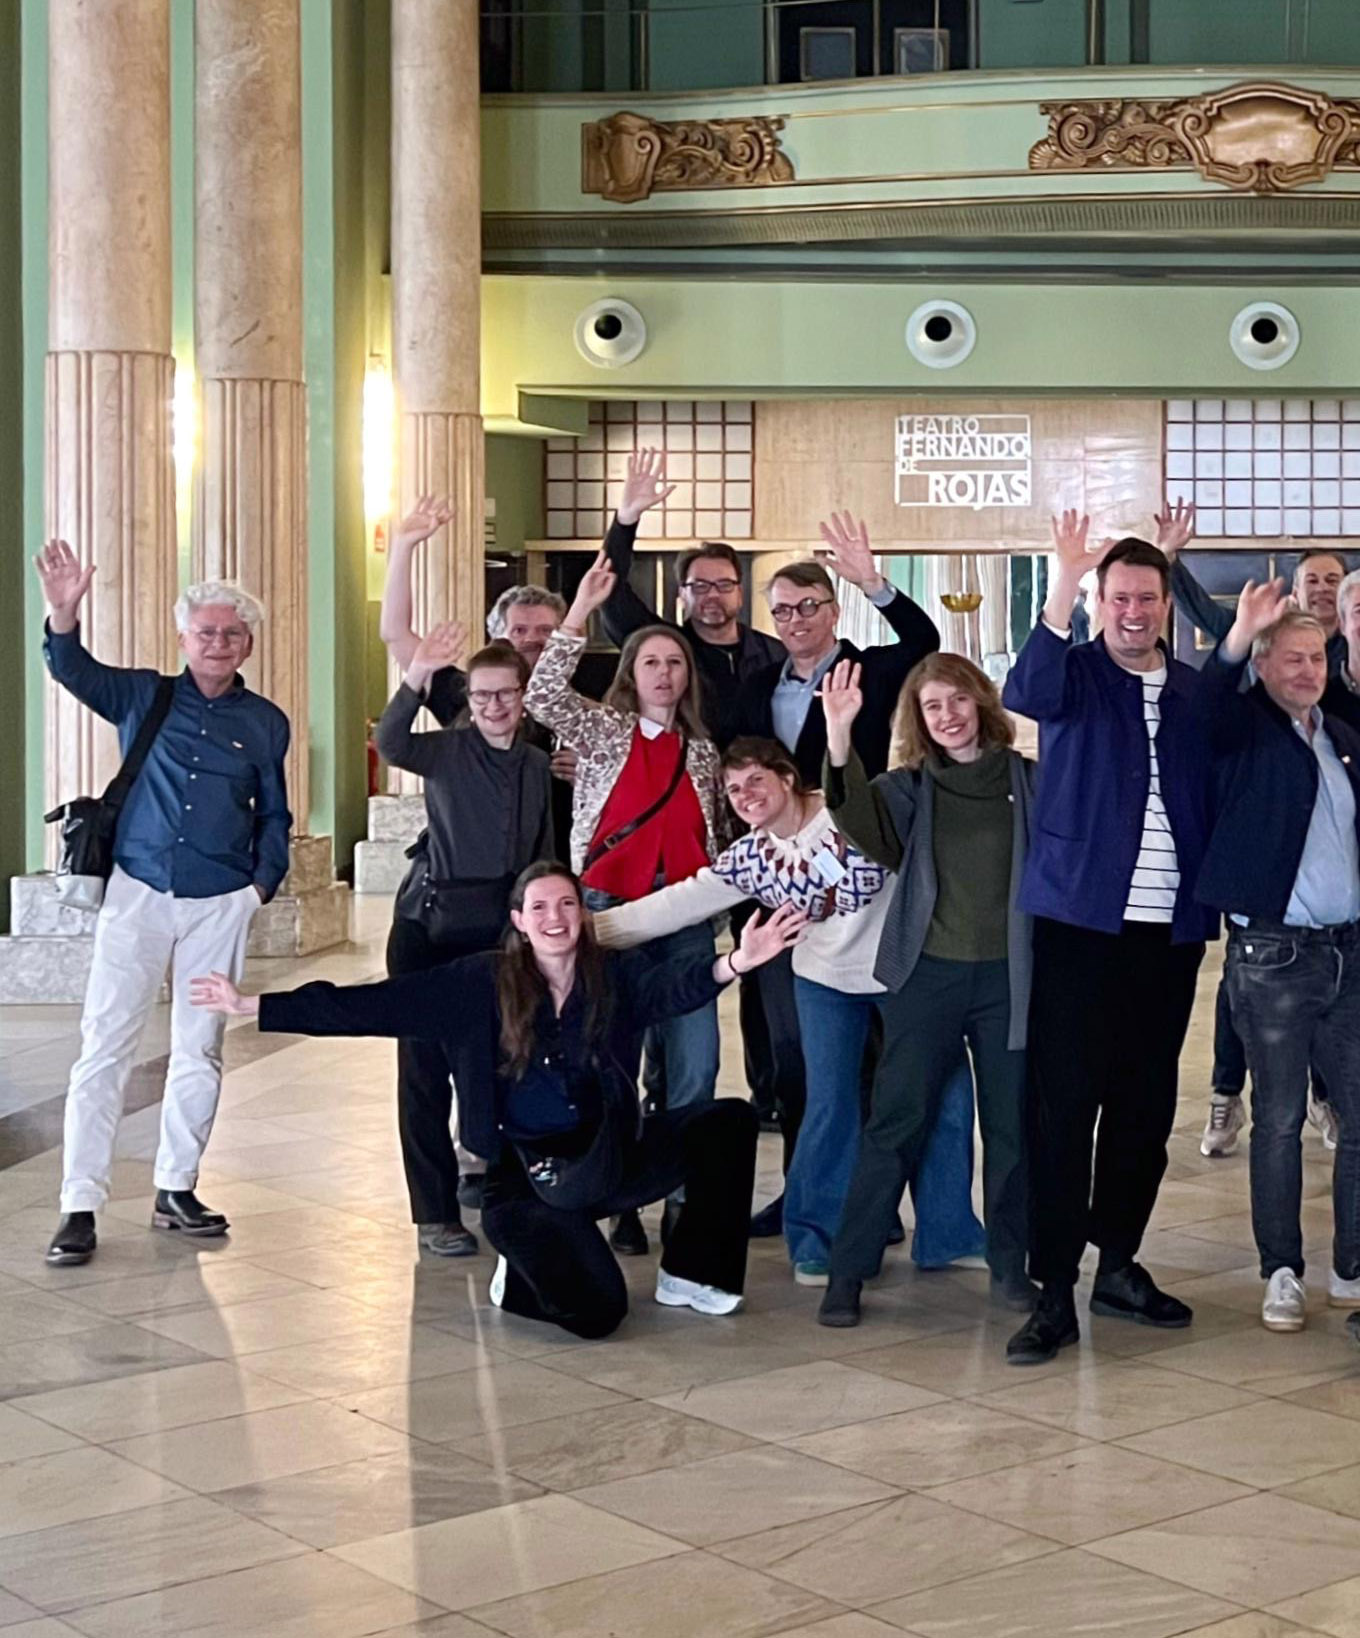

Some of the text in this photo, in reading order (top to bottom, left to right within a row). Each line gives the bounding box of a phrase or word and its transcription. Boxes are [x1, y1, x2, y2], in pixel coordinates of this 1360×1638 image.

[898, 416, 979, 434] TEATRO
[897, 435, 1029, 457] FERNANDO
[929, 474, 1029, 510] ROJAS
